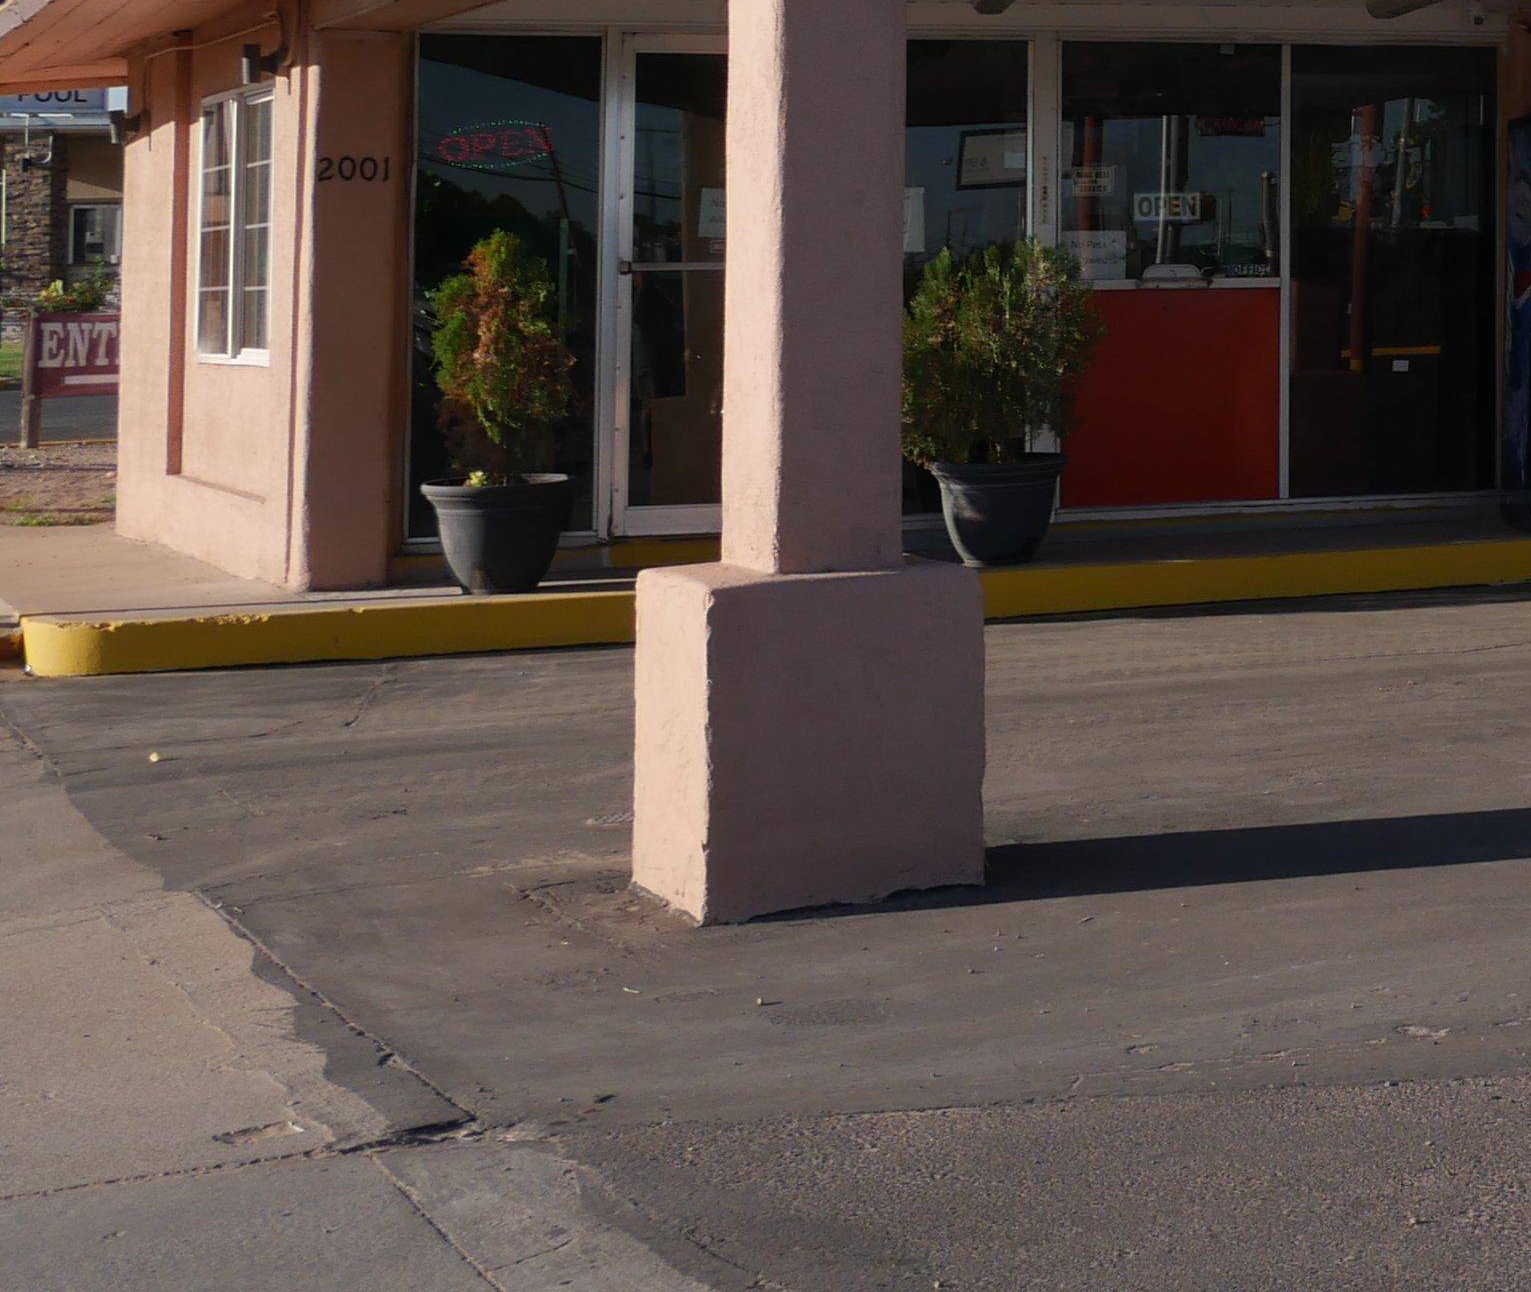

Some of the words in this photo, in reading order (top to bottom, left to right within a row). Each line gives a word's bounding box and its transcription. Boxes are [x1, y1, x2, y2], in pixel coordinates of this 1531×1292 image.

[437, 127, 555, 162] OPEN
[318, 155, 390, 182] 2001
[1137, 196, 1197, 217] OPEN
[38, 321, 120, 368] ENT
